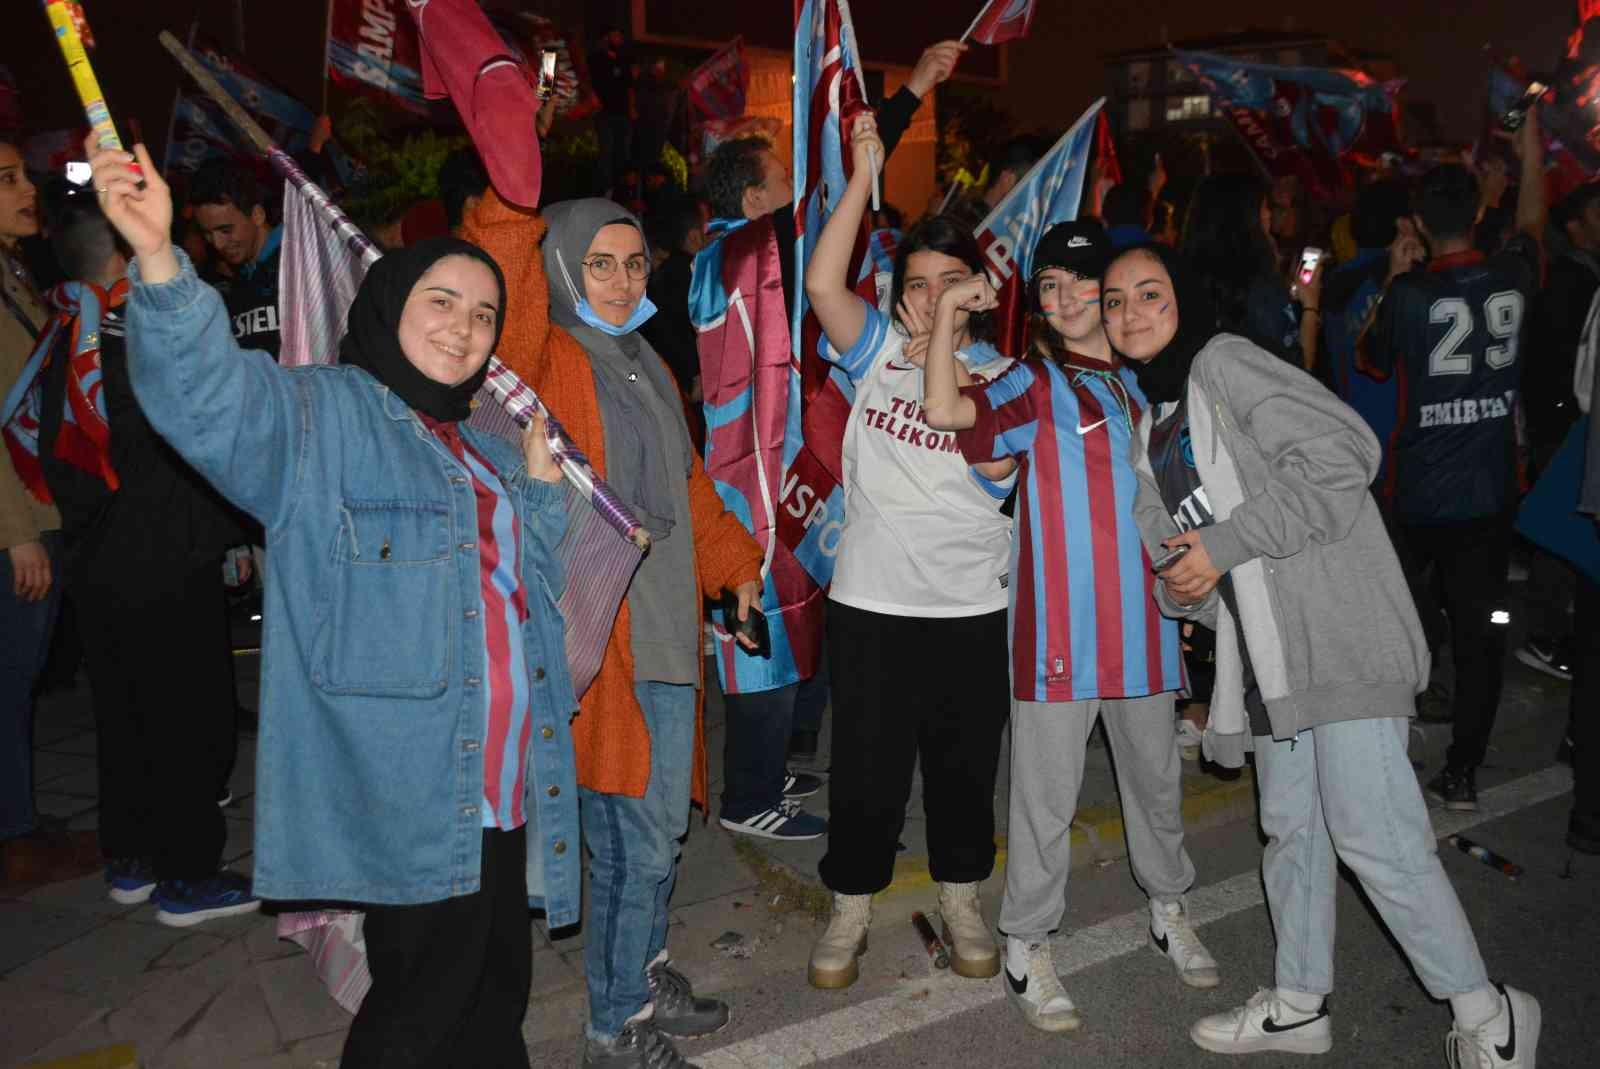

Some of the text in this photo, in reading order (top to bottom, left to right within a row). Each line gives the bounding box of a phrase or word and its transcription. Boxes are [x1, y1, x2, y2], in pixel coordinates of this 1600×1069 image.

[234, 304, 281, 338] STEL
[1428, 289, 1526, 377] 29
[865, 408, 961, 454] TELEKOM
